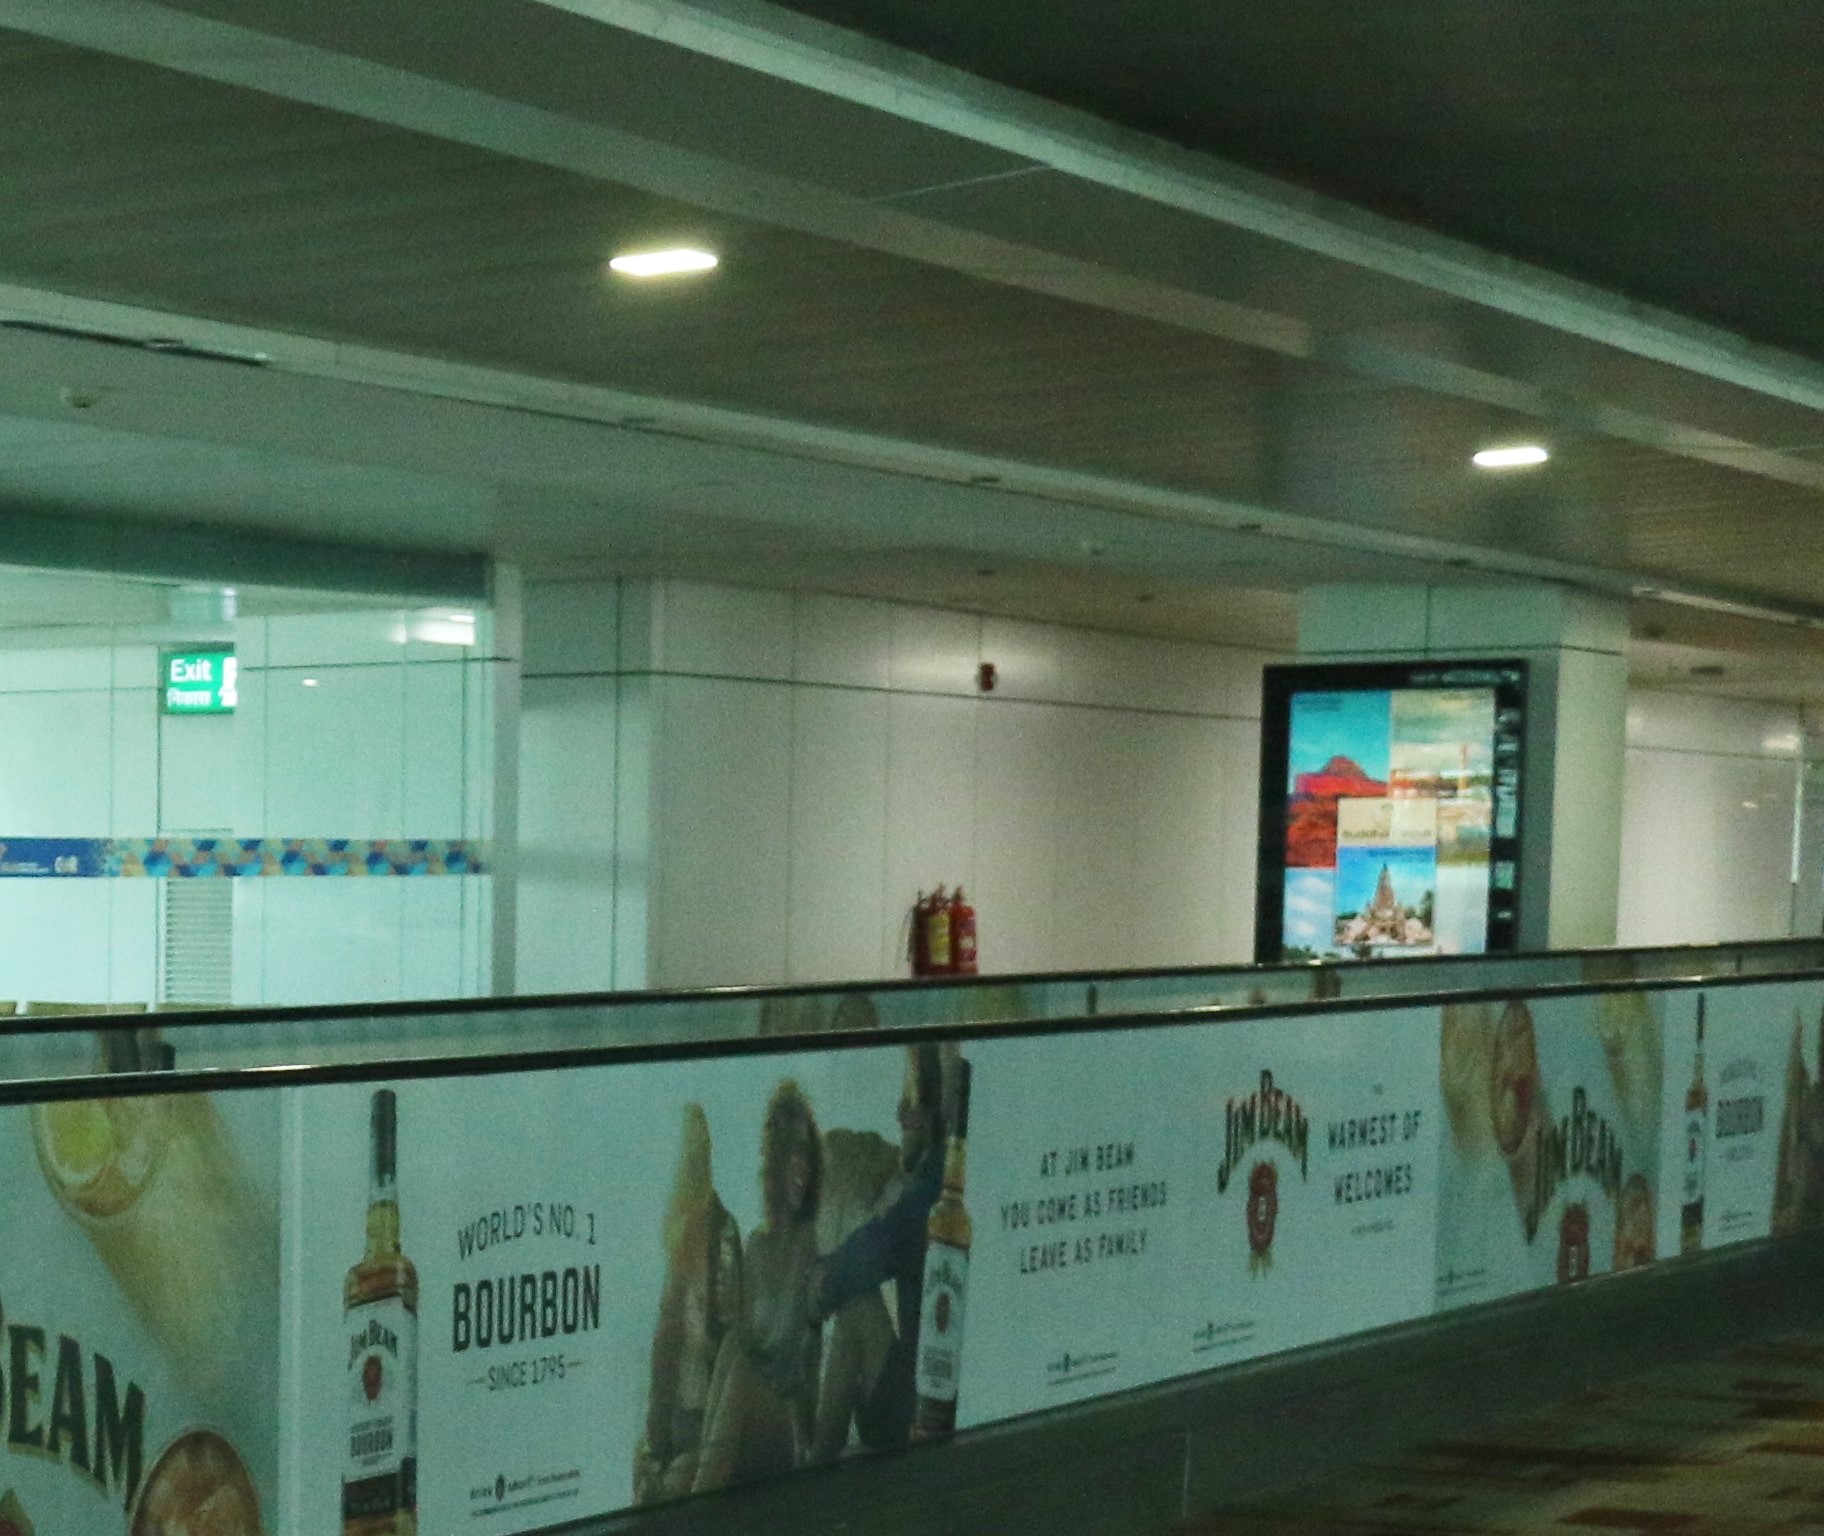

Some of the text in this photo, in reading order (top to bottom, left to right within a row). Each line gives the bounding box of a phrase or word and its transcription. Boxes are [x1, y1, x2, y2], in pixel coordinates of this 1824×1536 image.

[170, 658, 212, 682] Exit
[1040, 1151, 1058, 1178] AT
[1096, 1142, 1135, 1171] BEAM
[1083, 1191, 1101, 1217] AS
[457, 1202, 543, 1261] WORLD'S
[586, 1212, 596, 1246] 1
[453, 1263, 601, 1353] BOURBON
[487, 1360, 527, 1391] SINCE
